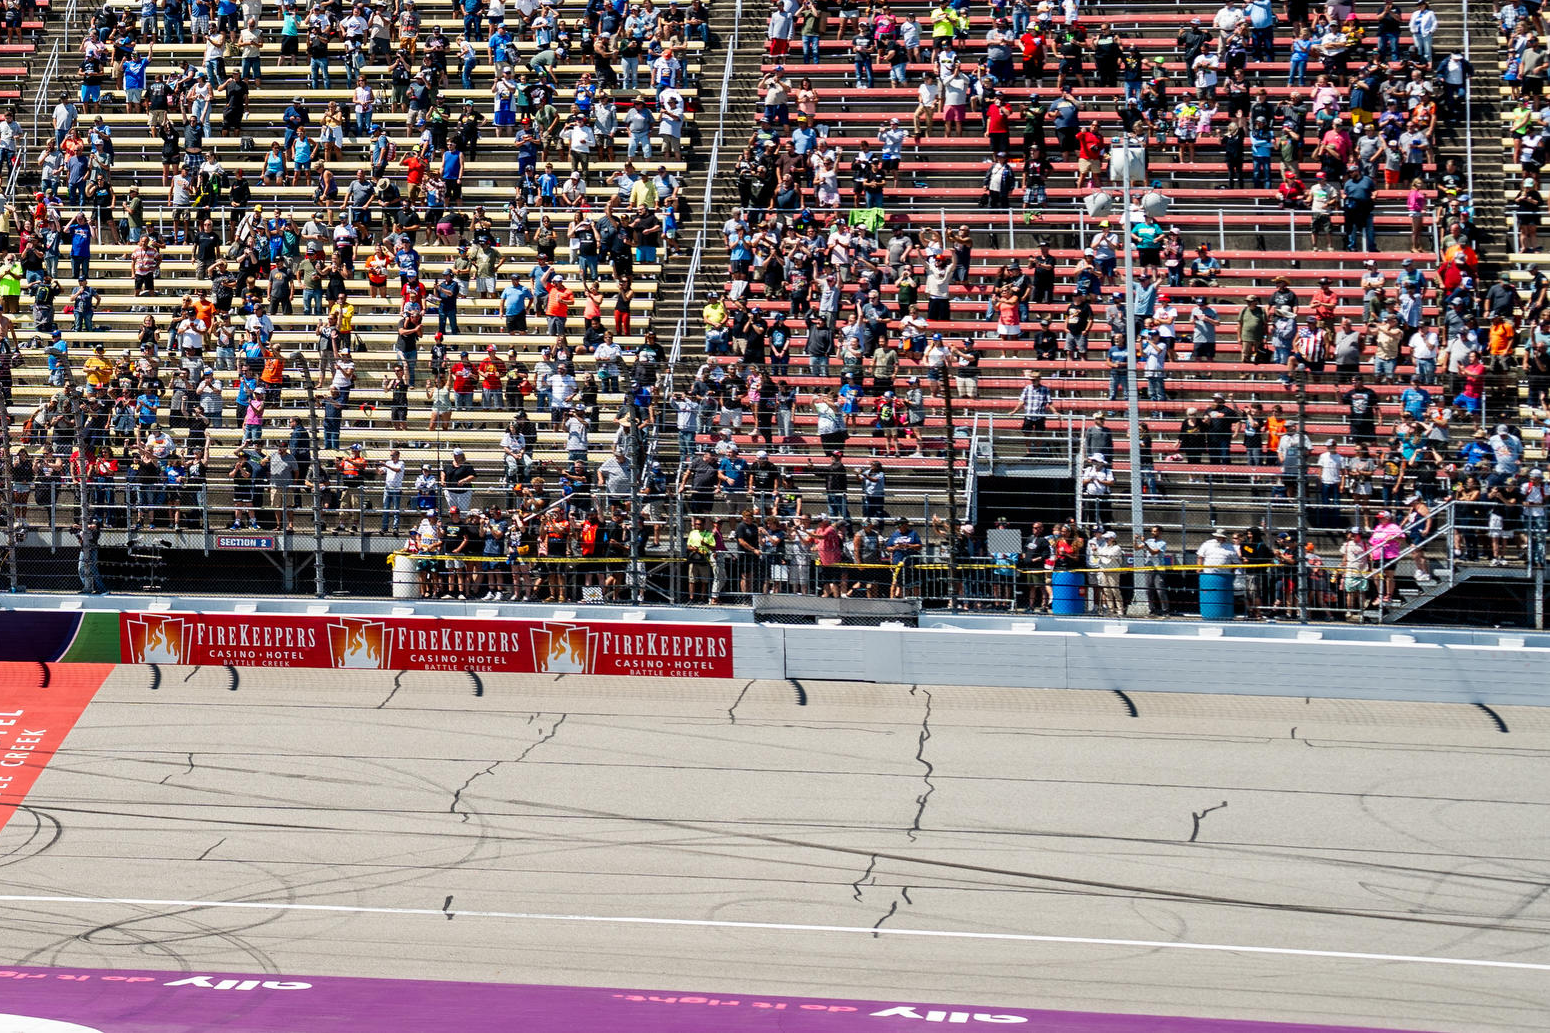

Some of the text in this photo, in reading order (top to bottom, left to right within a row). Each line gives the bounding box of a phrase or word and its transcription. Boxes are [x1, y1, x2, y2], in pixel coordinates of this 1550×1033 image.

[220, 538, 257, 547] SECTION
[197, 623, 315, 648] FIREKEEPERS
[397, 627, 519, 653] FIREKEEPERS
[602, 631, 727, 658] FIREKEEPERS
[209, 649, 304, 660] CASINO HOTEL
[410, 654, 506, 664] CASINO HOTEL
[223, 659, 290, 668] BATTLE CREEK
[463, 664, 492, 672] CREEK
[615, 659, 714, 670] CASINO HOTEL
[670, 669, 700, 677] CREEK
[0, 728, 47, 767] CREEK
[163, 976, 313, 991] ally
[868, 1006, 1029, 1024] ally
